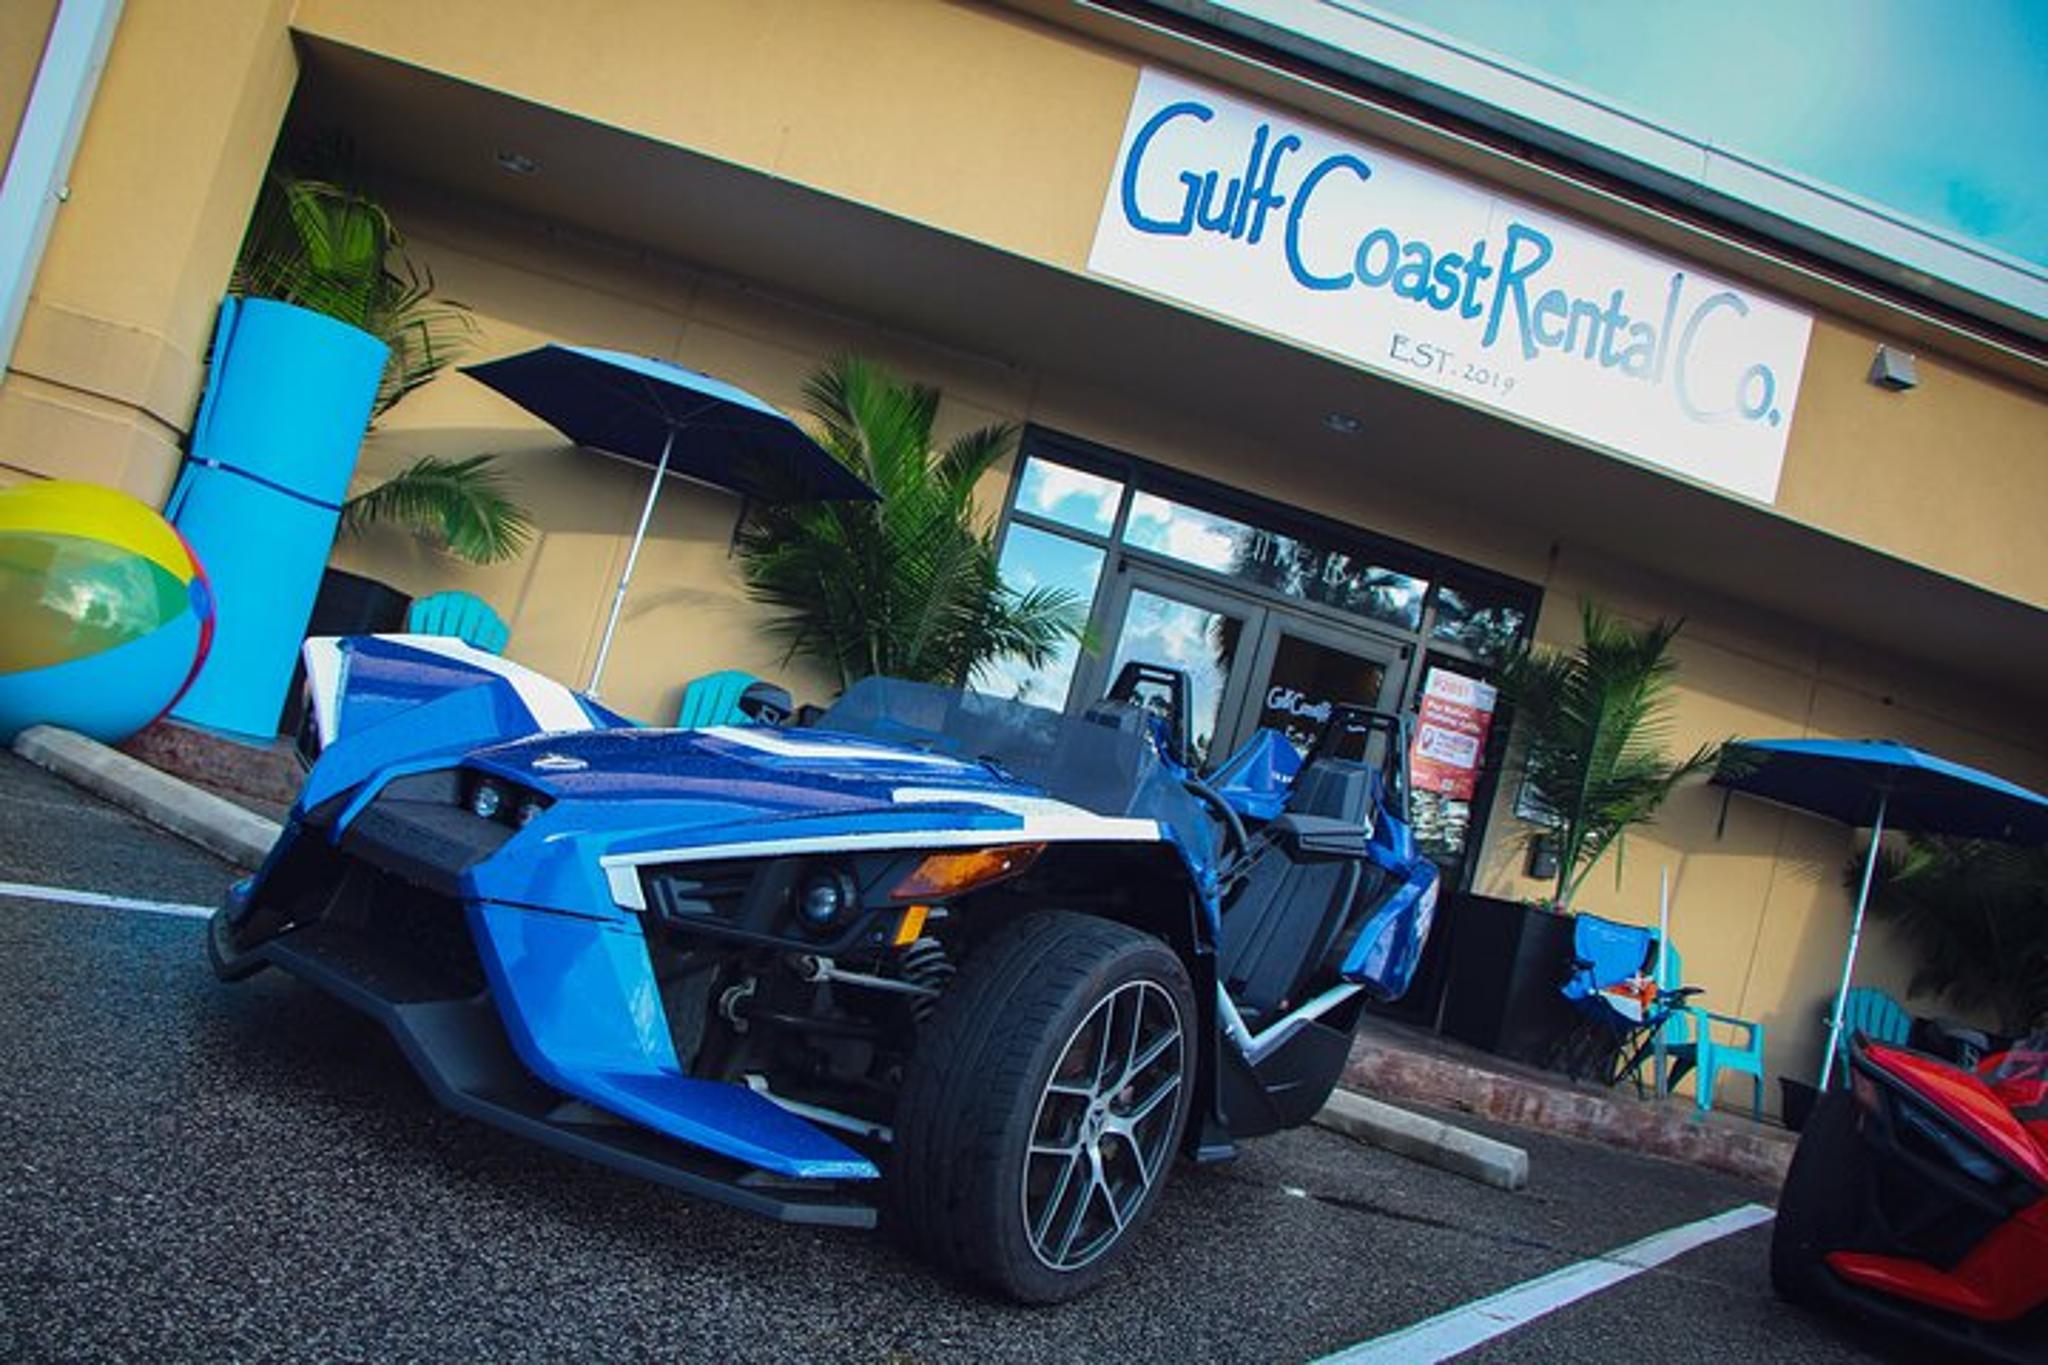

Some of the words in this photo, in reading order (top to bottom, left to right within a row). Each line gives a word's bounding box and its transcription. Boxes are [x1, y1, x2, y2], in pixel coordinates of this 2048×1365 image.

[1122, 102, 1301, 244] Gulf
[1286, 155, 1491, 318] Coast
[1483, 223, 1683, 384] Rental
[1677, 292, 1781, 425] Co.
[1389, 333, 1457, 375] EST.
[1463, 363, 1514, 396] 2019
